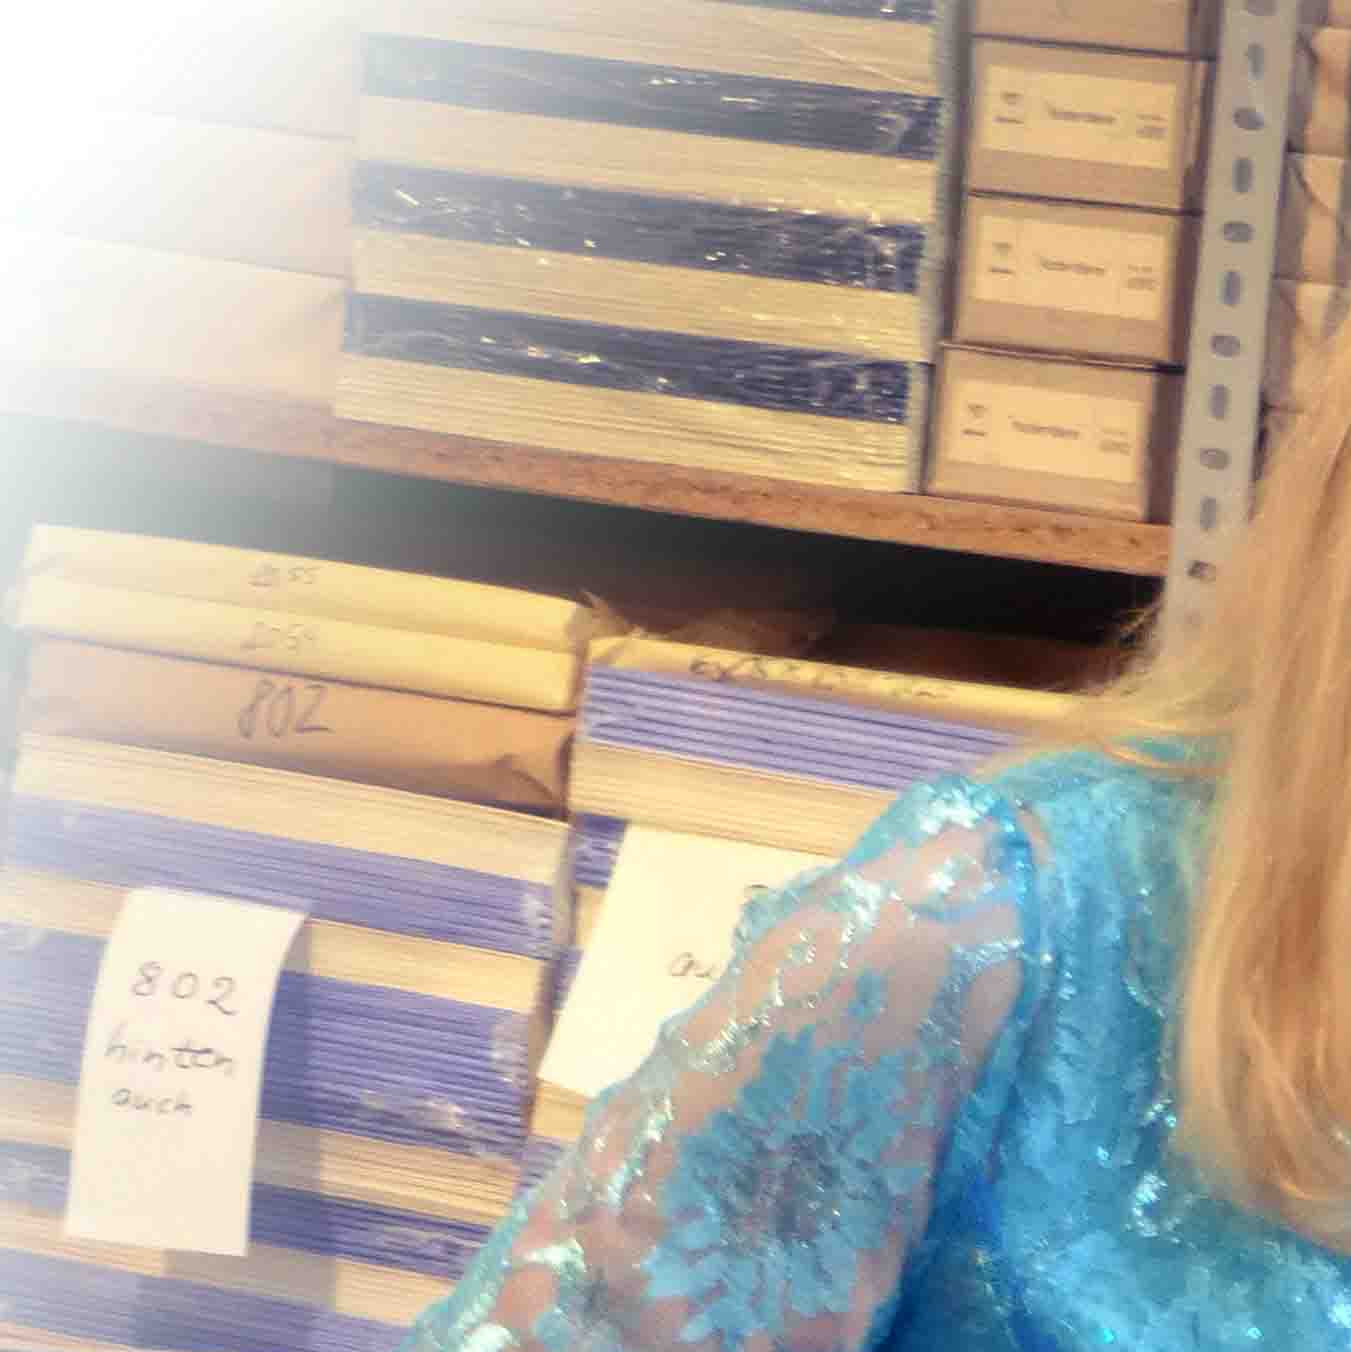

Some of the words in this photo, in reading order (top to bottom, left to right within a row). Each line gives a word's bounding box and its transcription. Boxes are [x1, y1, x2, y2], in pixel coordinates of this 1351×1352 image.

[239, 677, 334, 740] 802
[132, 961, 240, 1017] 802
[104, 1020, 235, 1078] hinten
